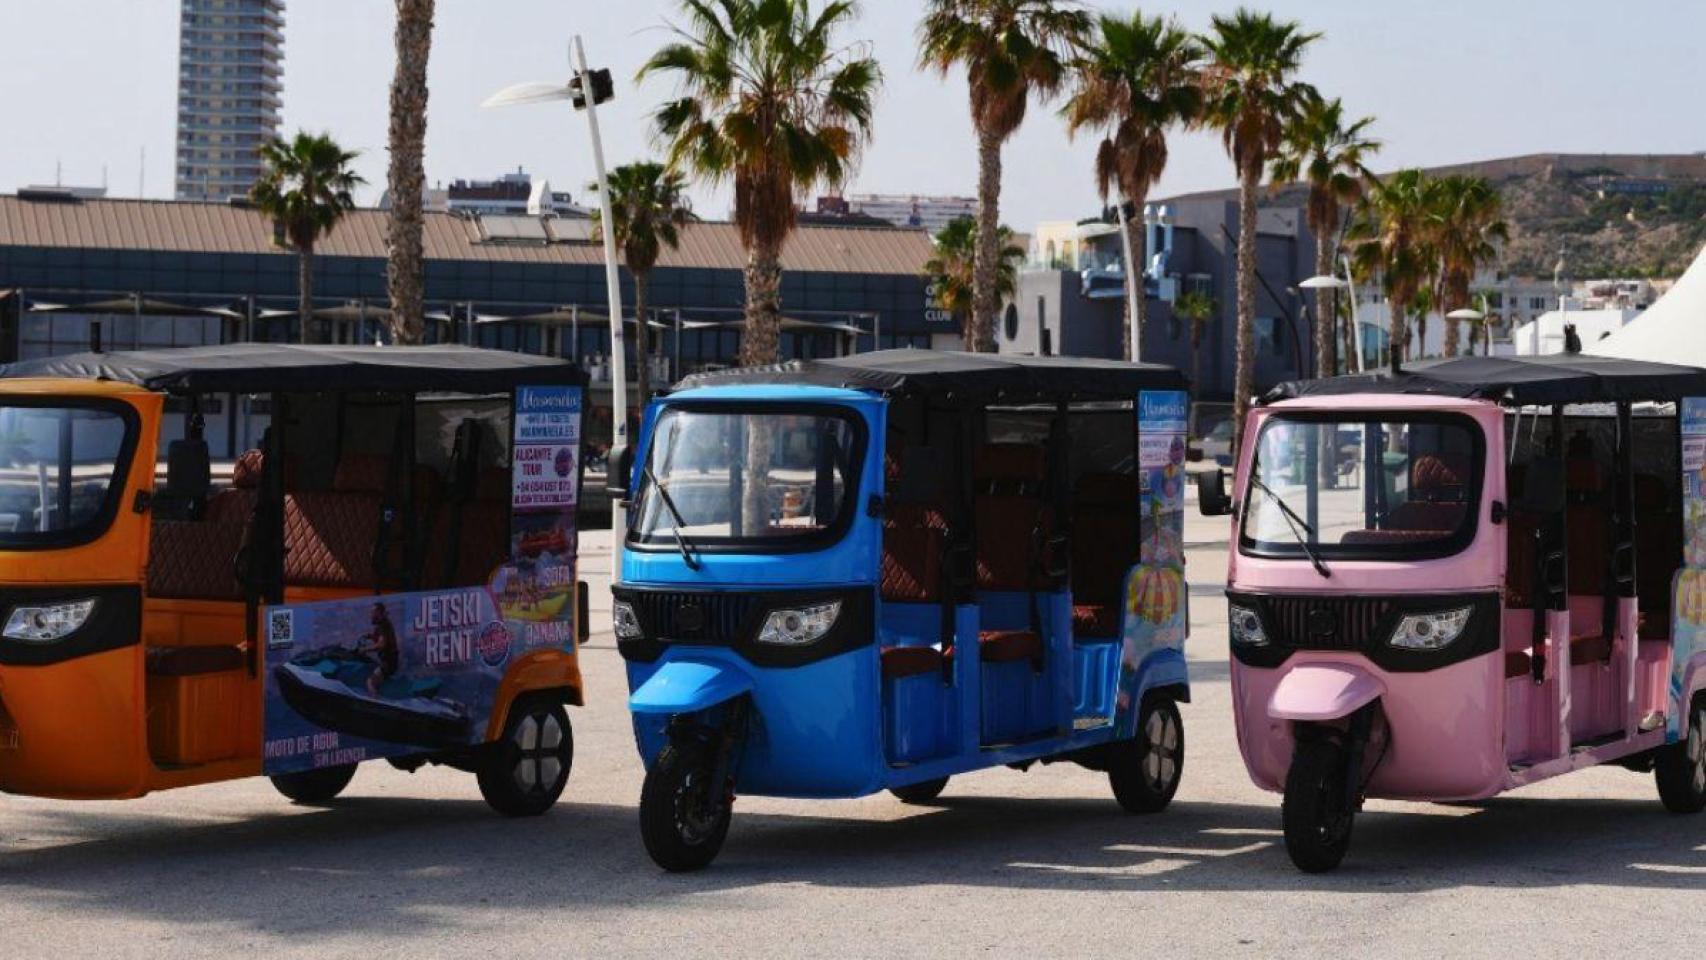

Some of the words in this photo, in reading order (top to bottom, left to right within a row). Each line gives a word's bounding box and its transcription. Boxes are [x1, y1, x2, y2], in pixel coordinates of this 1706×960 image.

[515, 447, 552, 461] ALICANTE
[522, 463, 543, 476] TOUR
[414, 591, 481, 632] JETSKI
[524, 621, 571, 646] BANANA
[425, 629, 474, 666] RENT
[264, 737, 295, 759] MOTO
[297, 735, 310, 754] DE
[313, 731, 339, 750] AGUA
